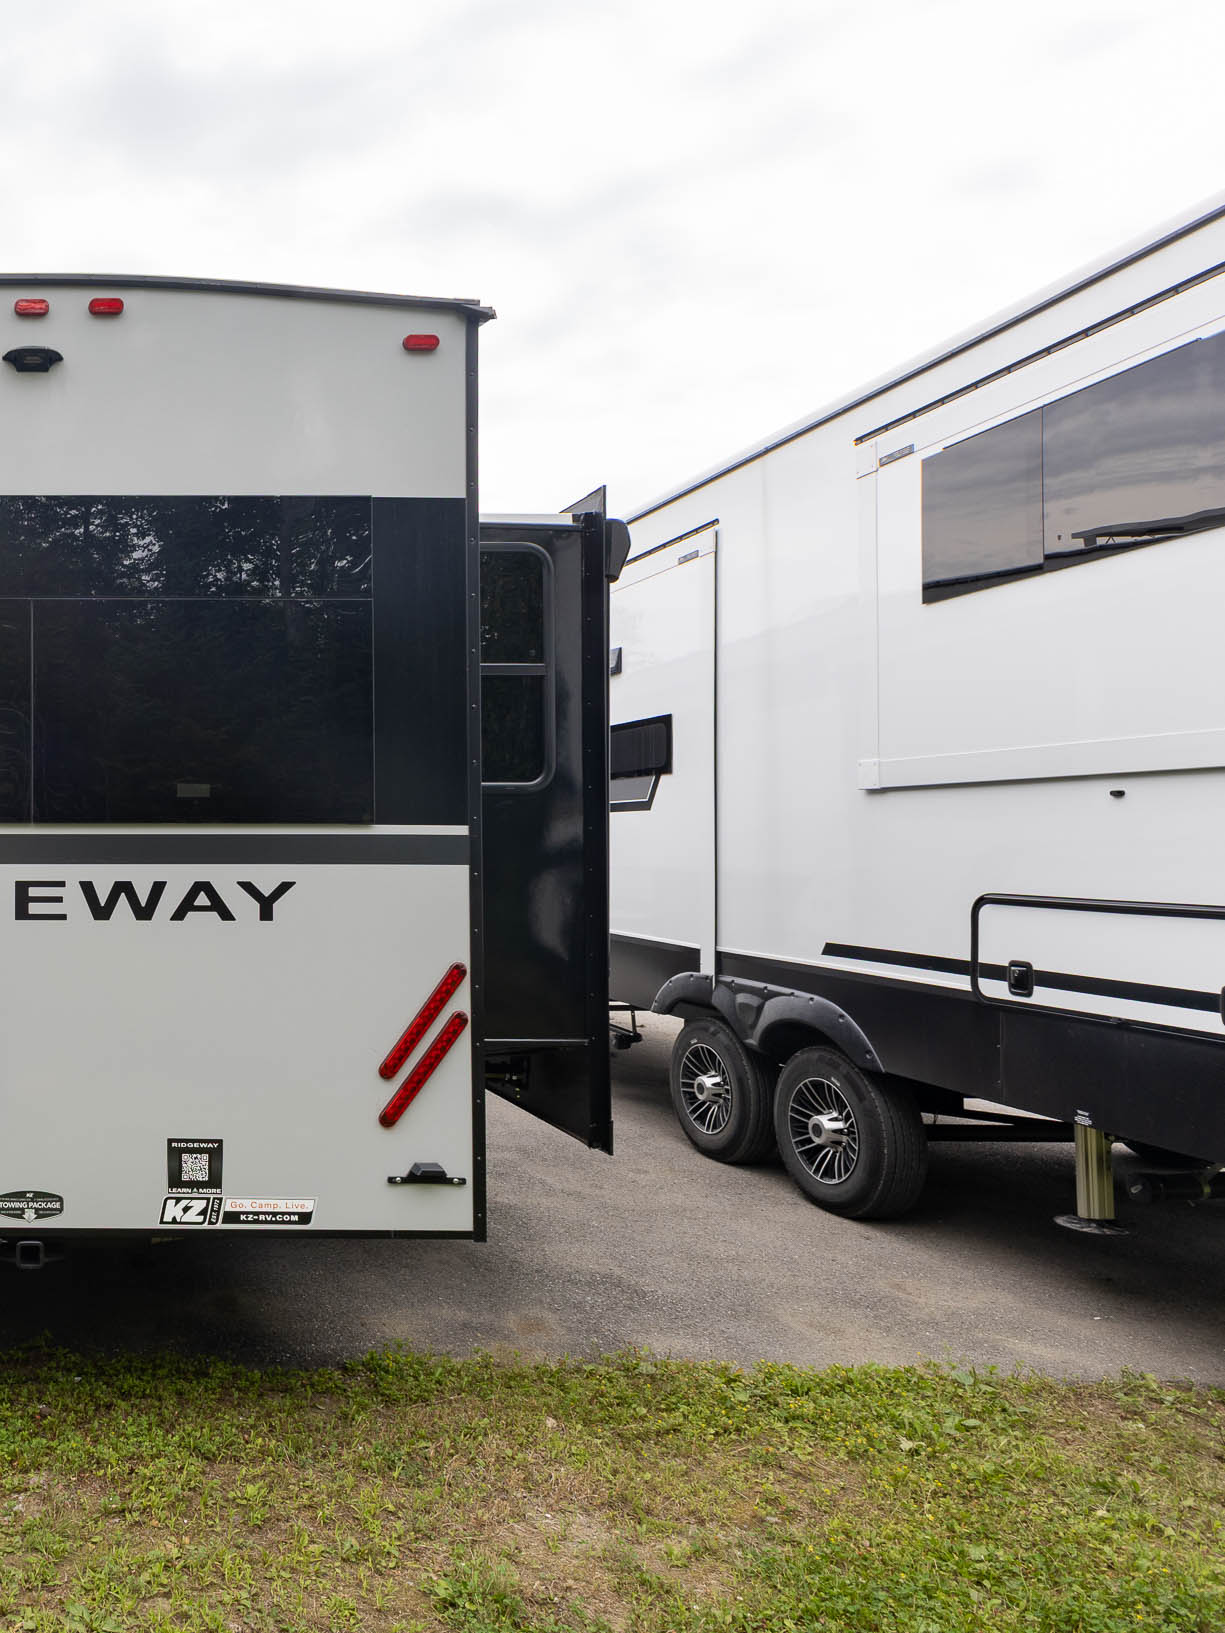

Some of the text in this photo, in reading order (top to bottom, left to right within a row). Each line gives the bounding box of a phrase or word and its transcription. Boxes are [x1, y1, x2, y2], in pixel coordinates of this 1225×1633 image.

[163, 1199, 207, 1223] KZ
[230, 1201, 247, 1209] Go.
[250, 1201, 281, 1210] Camp.
